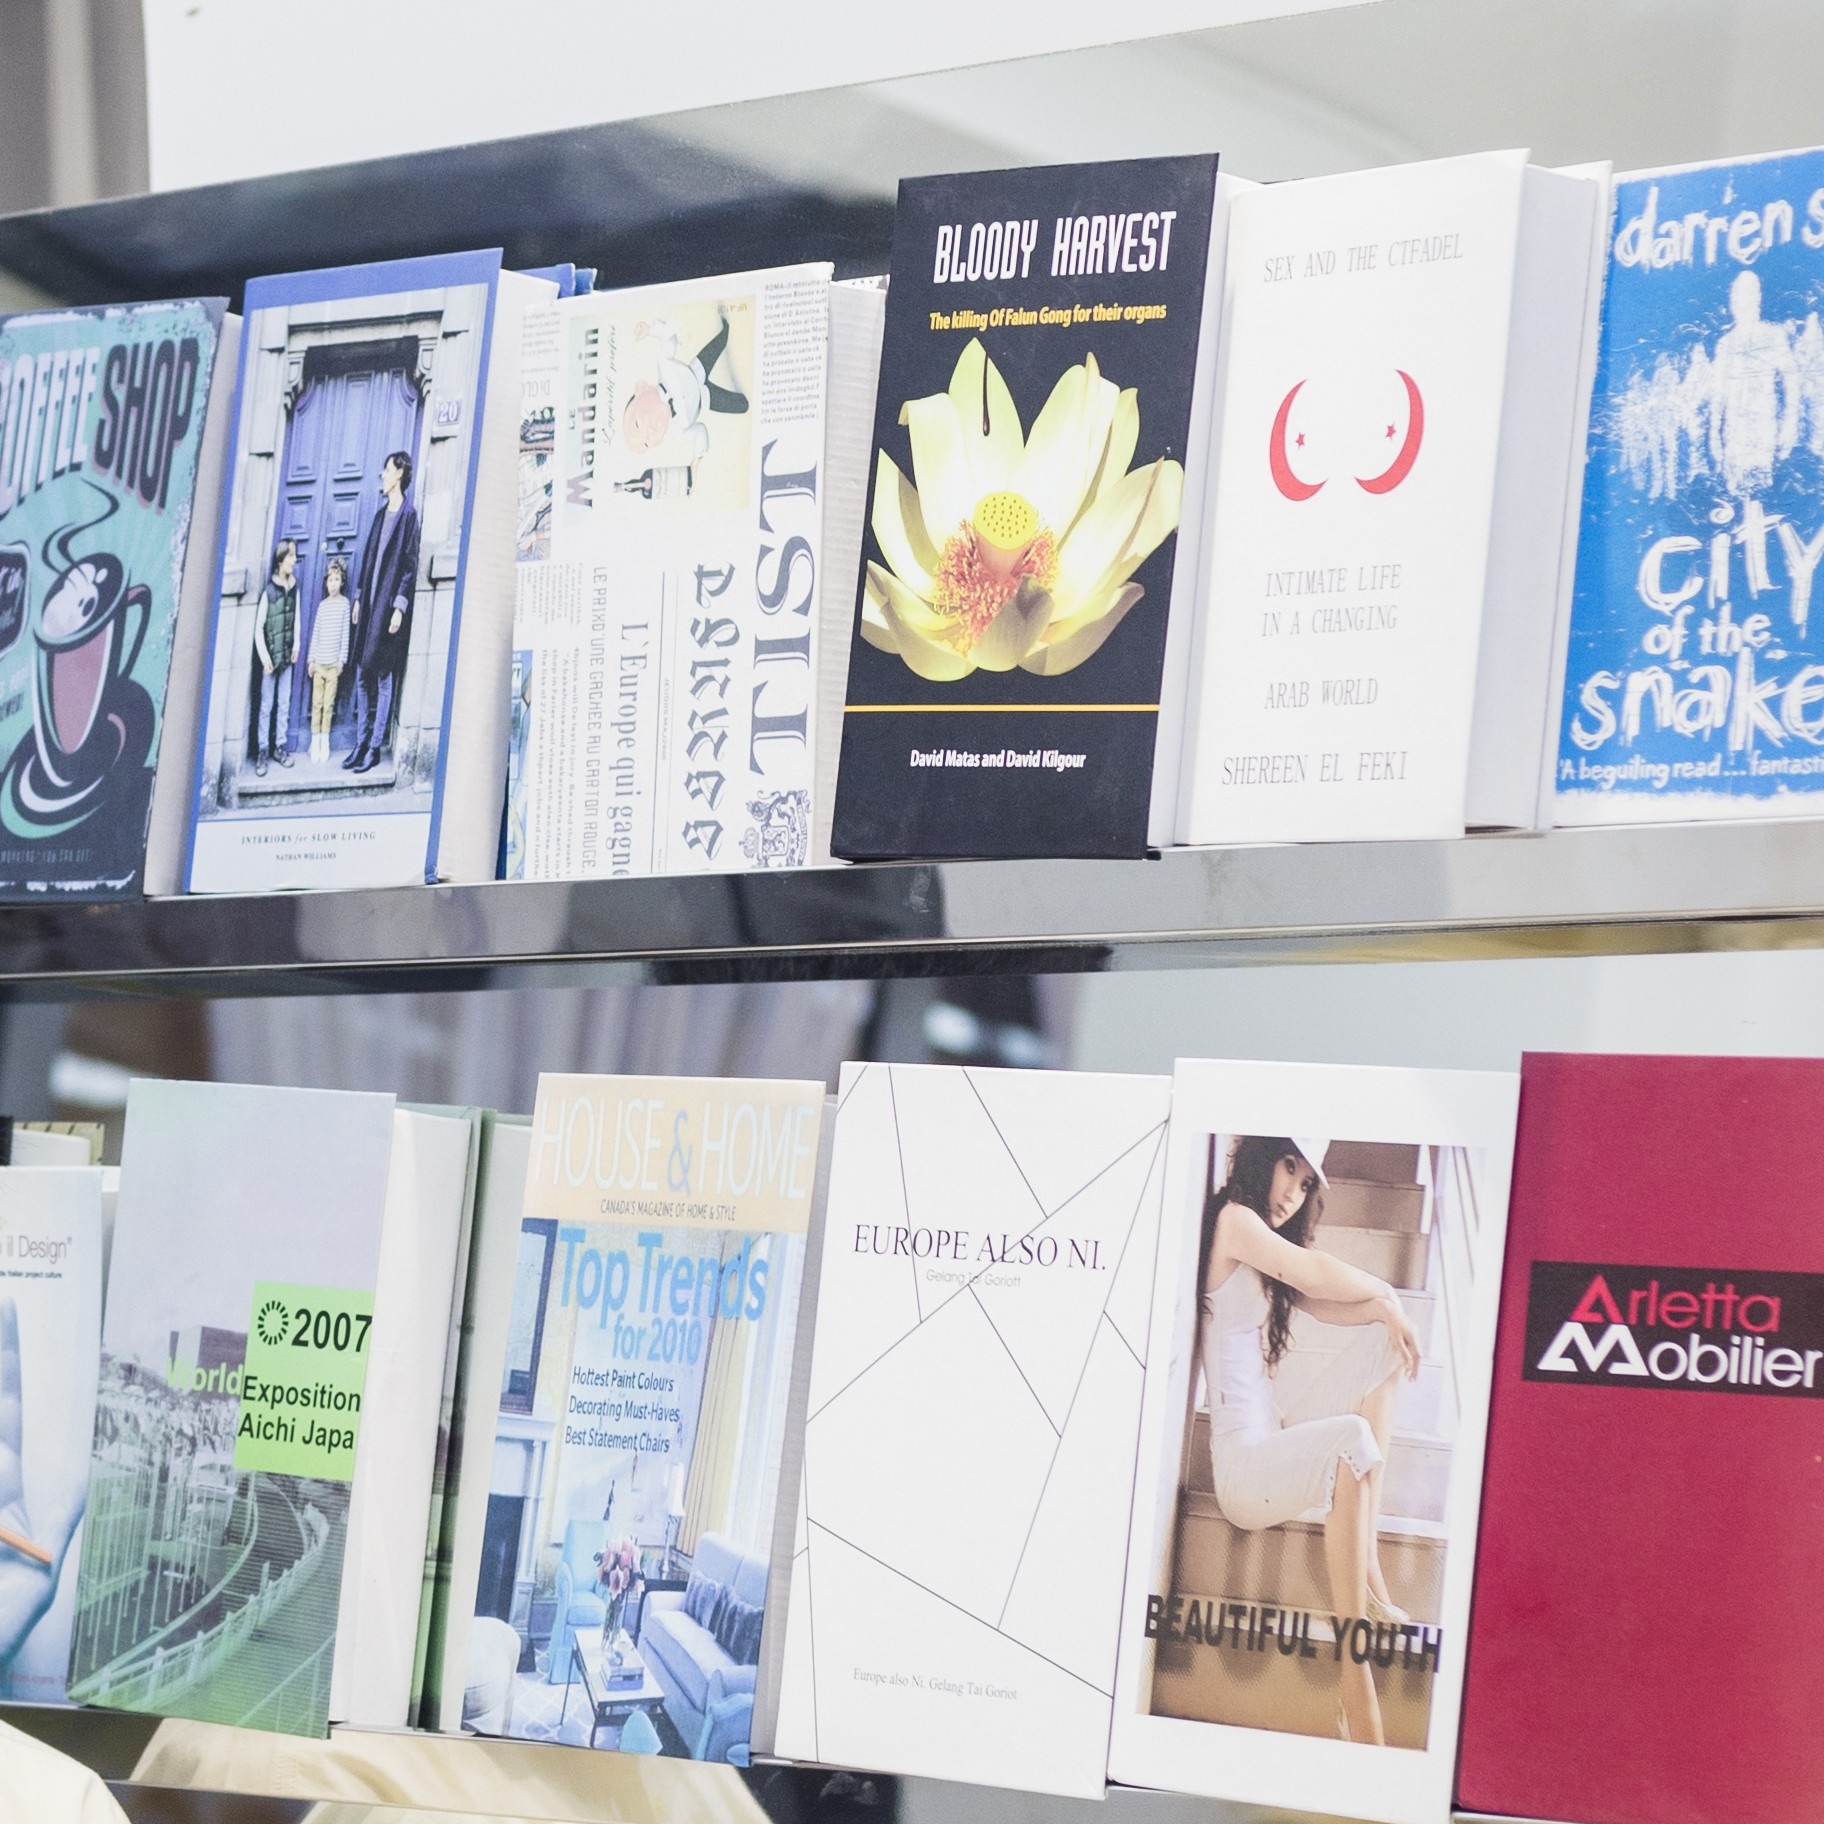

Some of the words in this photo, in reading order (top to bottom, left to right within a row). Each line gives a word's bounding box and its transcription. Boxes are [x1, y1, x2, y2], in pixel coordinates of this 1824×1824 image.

[932, 219, 1039, 284] BLOODY
[1051, 210, 1177, 277] HARVEST
[1614, 186, 1793, 269] darren
[1263, 256, 1295, 284] SEX
[1303, 250, 1336, 279] AND
[1346, 245, 1378, 273] THE
[929, 312, 950, 331] The
[951, 309, 988, 332] killing
[989, 307, 1005, 327] Of
[1005, 306, 1038, 326] Falun
[1039, 305, 1071, 328] Gong
[1072, 303, 1094, 323] for
[1093, 303, 1123, 321] their
[1123, 304, 1167, 325] organs
[93, 337, 200, 512] SHOP
[566, 327, 600, 508] Mandarin
[1264, 567, 1348, 598] INTIMATE
[1358, 563, 1402, 592] LIFE
[1636, 497, 1824, 640] city
[748, 438, 818, 776] TIST
[1262, 611, 1282, 637] IN
[1290, 610, 1301, 635] A
[1311, 604, 1398, 634] CHANGING
[1642, 604, 1695, 660] of
[1698, 601, 1773, 657] the
[1264, 681, 1310, 709] ARAB
[1321, 678, 1379, 706] WORLD
[608, 756, 642, 798] qui
[910, 749, 942, 769] David
[944, 749, 980, 769] Matas
[981, 750, 1004, 769] and
[1005, 749, 1040, 769] David
[1041, 749, 1086, 775] Kilgour
[1222, 754, 1309, 785] SHEREEN
[1319, 752, 1344, 783] EL
[1357, 751, 1409, 782] FEKI
[1579, 754, 1671, 789] beguiling
[241, 834, 292, 845] INTERIORS
[311, 833, 338, 842] SLOW
[341, 831, 377, 841] LIVING
[276, 853, 302, 861] NATHAN
[304, 852, 336, 860] WILLIAMS
[532, 1096, 667, 1192] HOUSE
[667, 1109, 693, 1198] &
[696, 1100, 816, 1200] HOME
[600, 1198, 636, 1216] CANADA'S
[637, 1202, 674, 1218] MAGAZINE
[675, 1203, 686, 1218] OF
[687, 1204, 708, 1219] HOME
[716, 1205, 736, 1221] STYLE
[853, 1223, 970, 1260] EUROPE
[976, 1233, 1058, 1267] ALSO
[559, 1226, 630, 1330] Top
[637, 1231, 770, 1322] Trends
[926, 1268, 965, 1286] Gelang
[1570, 1273, 1782, 1334] Arletta
[291, 1308, 373, 1353] 2007
[612, 1312, 646, 1361] for
[648, 1317, 704, 1367] 2010
[1537, 1321, 1822, 1390] Mobilier
[166, 1357, 245, 1395] World
[242, 1374, 362, 1413] Exposition
[572, 1365, 610, 1387] Hottest
[610, 1369, 637, 1389] Paint
[637, 1371, 675, 1392] Colours
[238, 1411, 297, 1443] Aichi
[568, 1395, 622, 1422] Decorating
[623, 1399, 680, 1423] Must-Haves
[565, 1425, 587, 1446] Best
[587, 1428, 638, 1452] Statement
[639, 1432, 670, 1454] Chairs
[1143, 1594, 1317, 1659] BEAUTIFUL
[1328, 1616, 1443, 1673] YOUTH
[853, 1667, 888, 1686] Europe
[889, 1672, 909, 1687] also
[929, 1677, 964, 1697] Gelang
[966, 1681, 983, 1696] Tai
[985, 1684, 1018, 1700] Goriot
